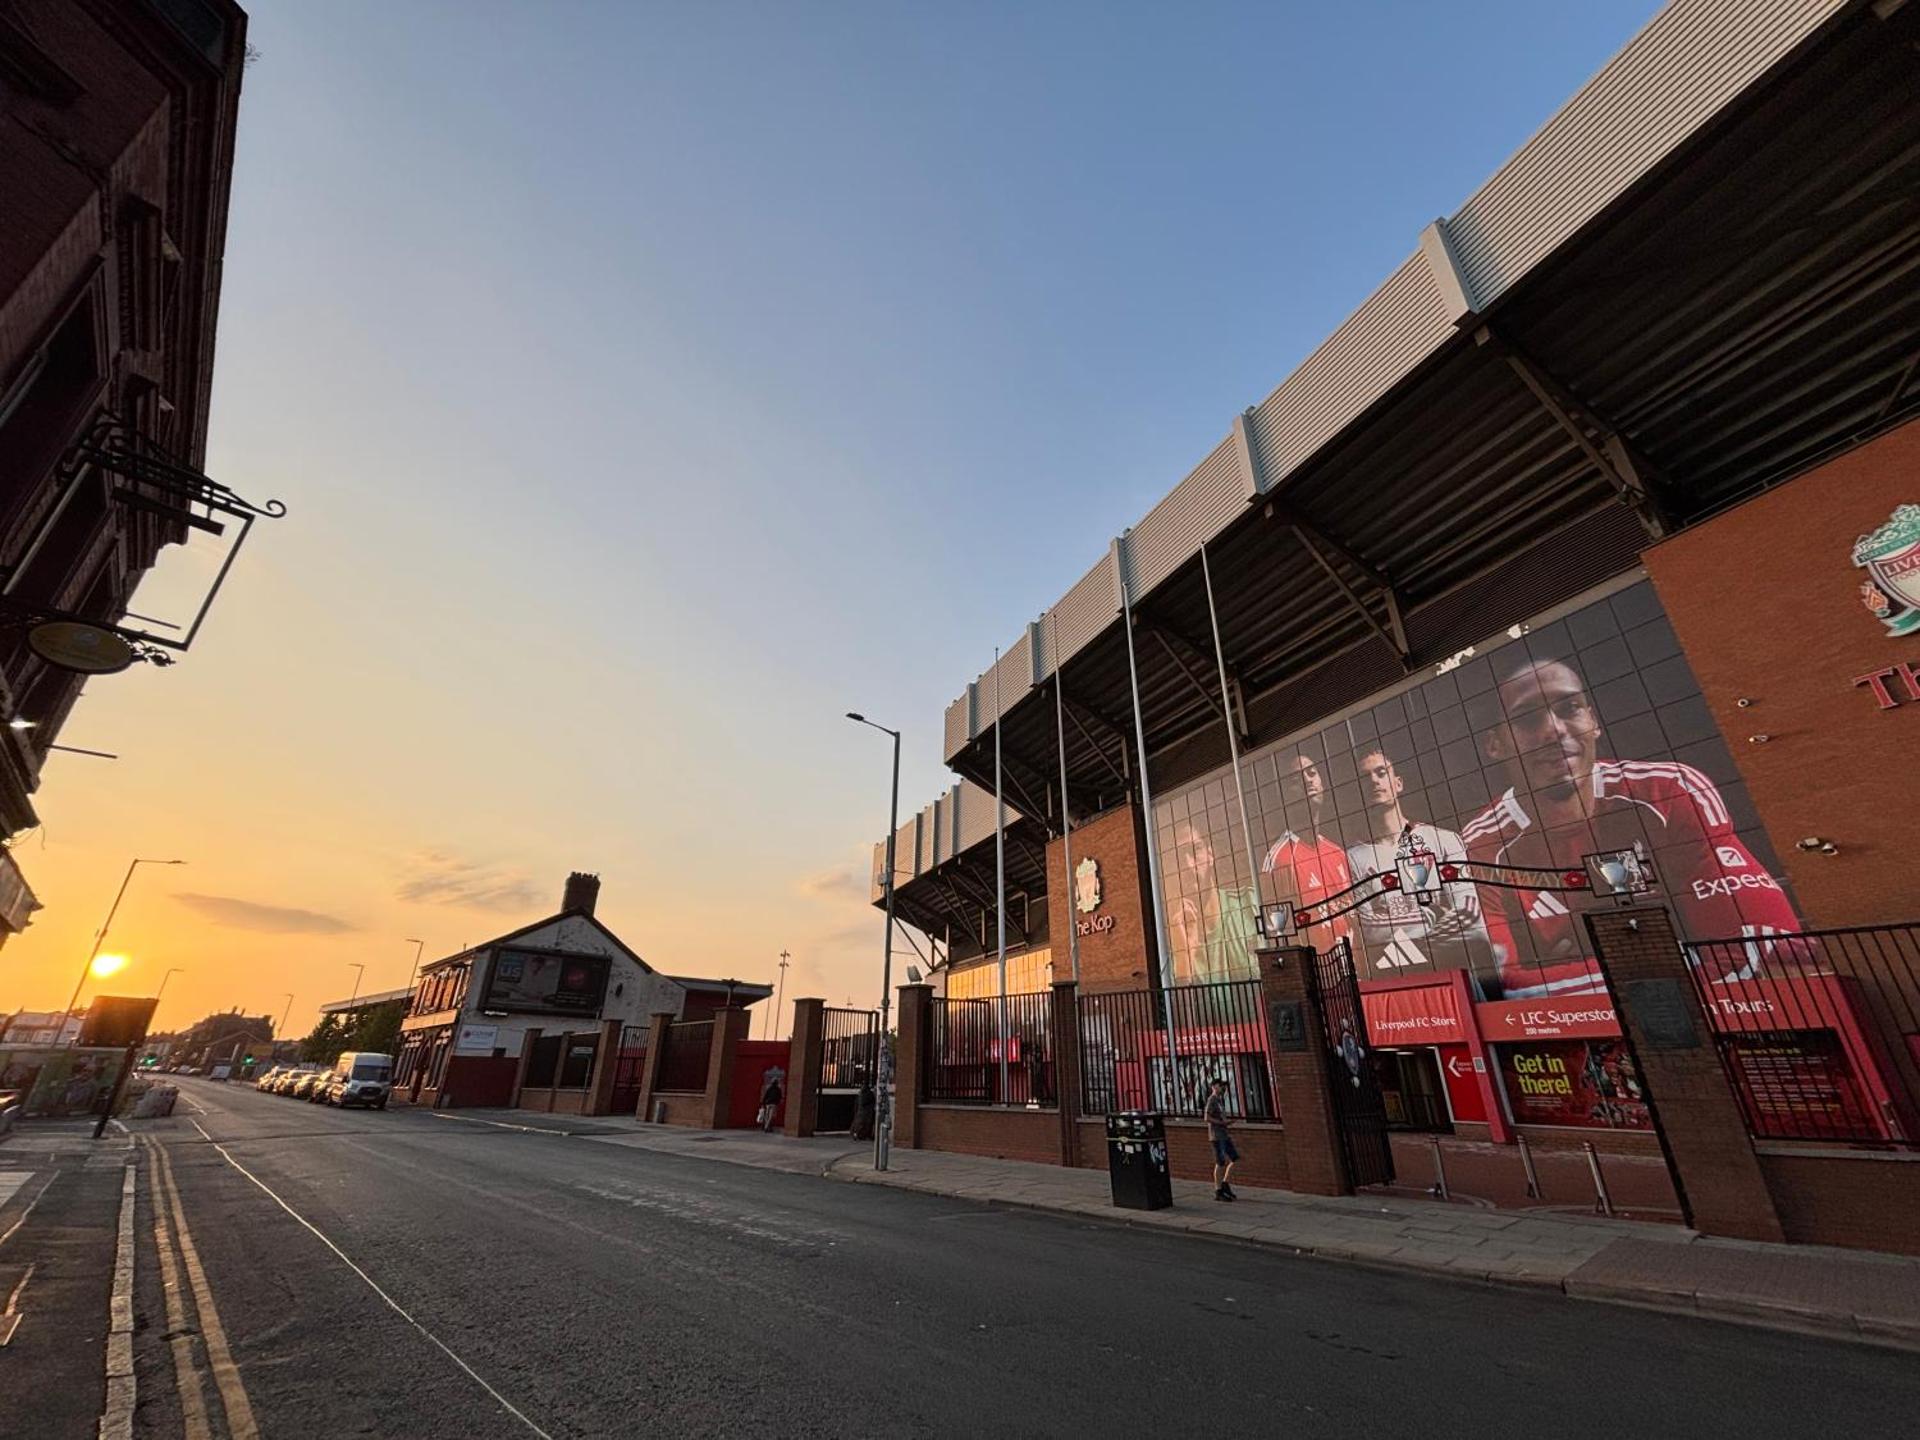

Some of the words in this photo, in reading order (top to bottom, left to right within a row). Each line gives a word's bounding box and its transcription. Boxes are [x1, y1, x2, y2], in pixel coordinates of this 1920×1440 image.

[1091, 914, 1113, 934] Kop
[1718, 999, 1774, 1014] Tours
[1375, 1017, 1415, 1031] Liverpool
[1416, 1016, 1430, 1028] FC
[1430, 1016, 1457, 1027] Store
[1520, 1010, 1546, 1025] LFC
[1513, 1053, 1546, 1074] Get
[1545, 1053, 1566, 1073] in
[1518, 1074, 1574, 1095] there!
